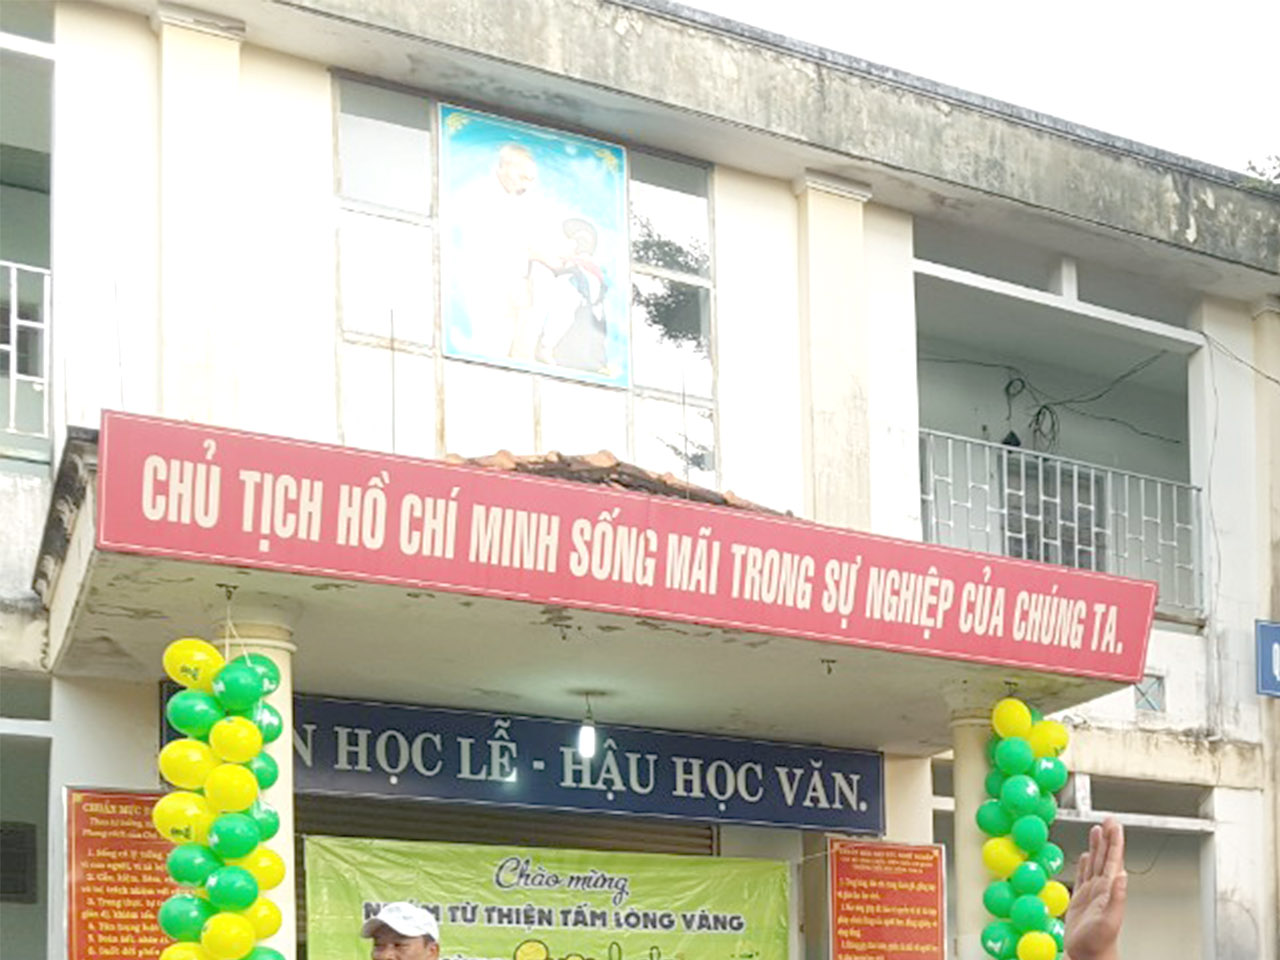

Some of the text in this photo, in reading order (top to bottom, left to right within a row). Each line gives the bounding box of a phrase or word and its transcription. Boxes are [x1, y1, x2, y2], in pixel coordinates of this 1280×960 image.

[141, 438, 1124, 655] CHỦ TỊCH HỒ CHÍ MINH SỐNG MÃI TRONG SỰ NGHIỆP CỦA CHÚNG TA.
[334, 725, 443, 785] HỌC
[457, 719, 517, 782] LỄ
[559, 738, 658, 801] HẬU
[671, 756, 764, 811] HỌC
[775, 759, 868, 812] VĂN.
[448, 901, 479, 923] TỪ
[484, 903, 552, 932] THIỆN
[559, 903, 608, 928] TẤM
[681, 909, 745, 932] VÀNG
[494, 856, 630, 906] Chào mừng
